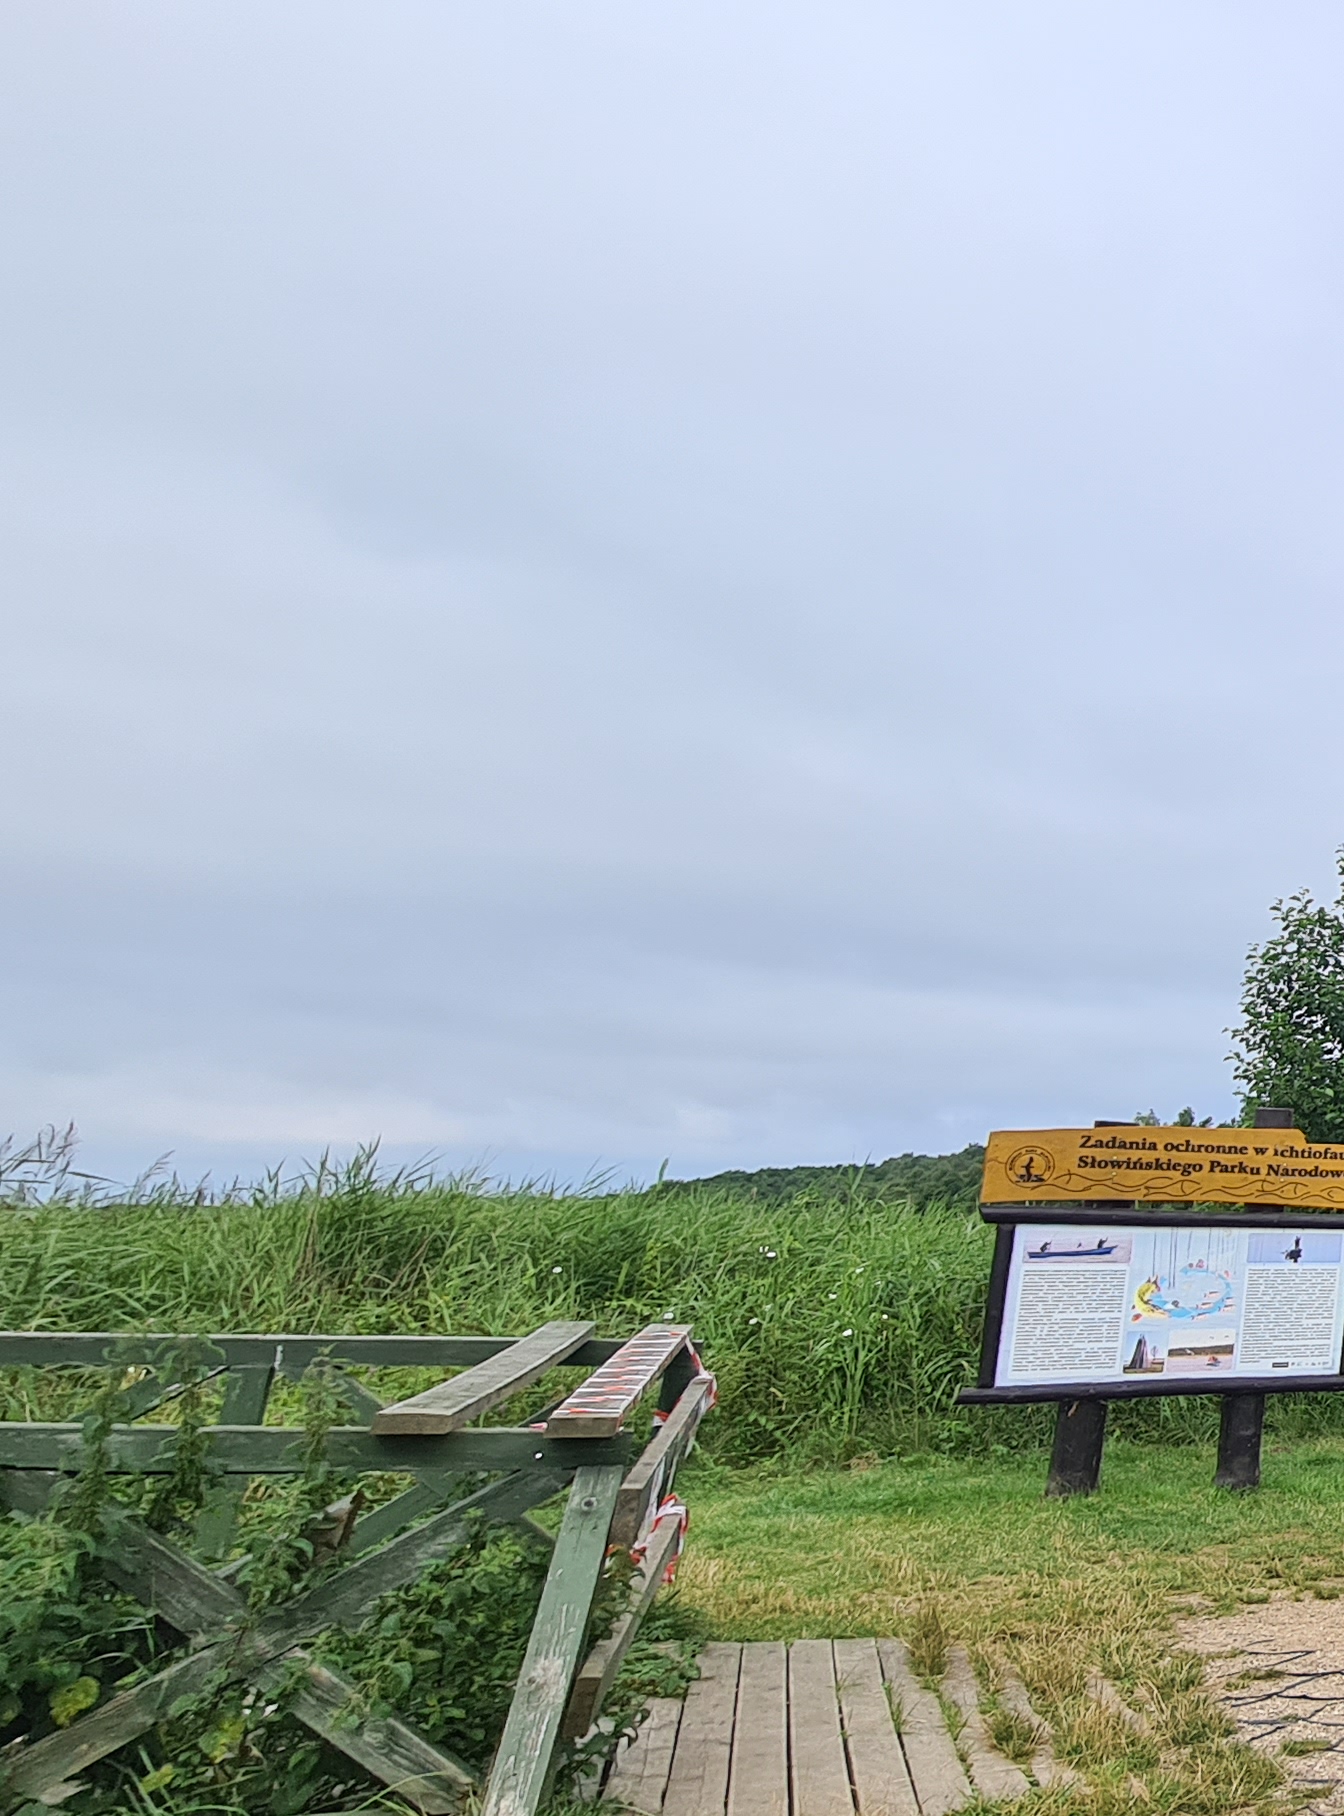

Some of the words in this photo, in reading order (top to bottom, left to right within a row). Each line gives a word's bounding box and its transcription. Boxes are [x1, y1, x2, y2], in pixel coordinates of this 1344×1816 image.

[1079, 1135, 1158, 1151] Zadania
[1164, 1139, 1249, 1155] ochronne
[1253, 1146, 1269, 1156] w
[1077, 1155, 1204, 1177] Słowińskiego
[1208, 1160, 1261, 1176] Parku
